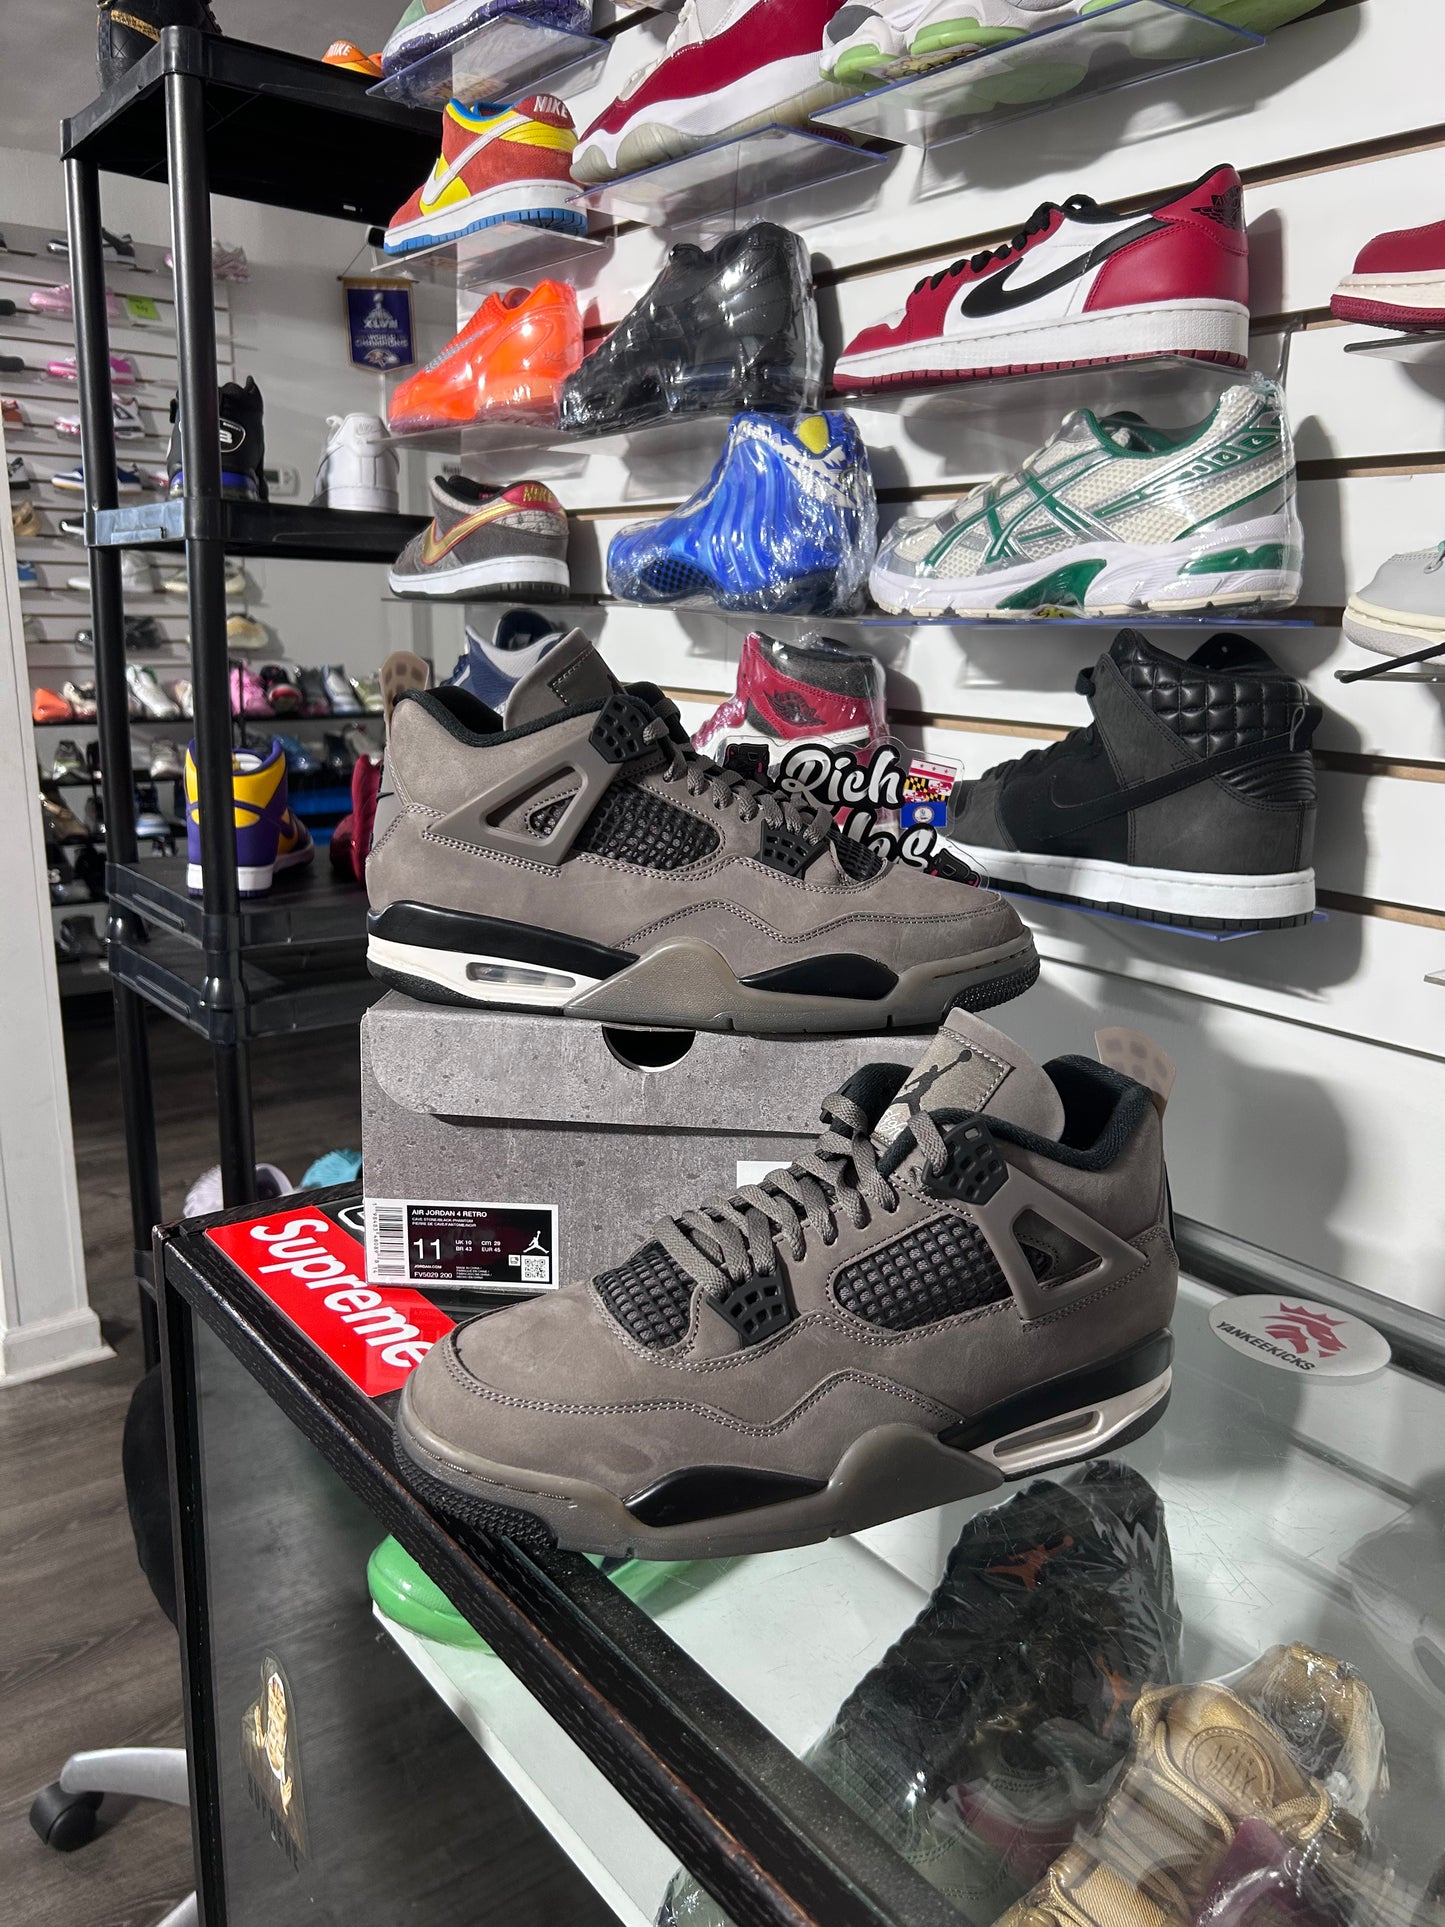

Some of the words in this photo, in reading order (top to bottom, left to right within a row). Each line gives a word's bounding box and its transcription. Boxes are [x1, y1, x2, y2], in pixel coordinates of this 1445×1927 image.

[327, 43, 353, 58] NIKE
[533, 95, 568, 119] NIKE
[523, 485, 553, 503] NIKE
[777, 745, 903, 812] Rich
[425, 1209, 455, 1217] JORDAN
[413, 1238, 441, 1260] 11
[249, 1218, 435, 1368] Supreme
[1216, 1321, 1316, 1370] YANKEEKICKS
